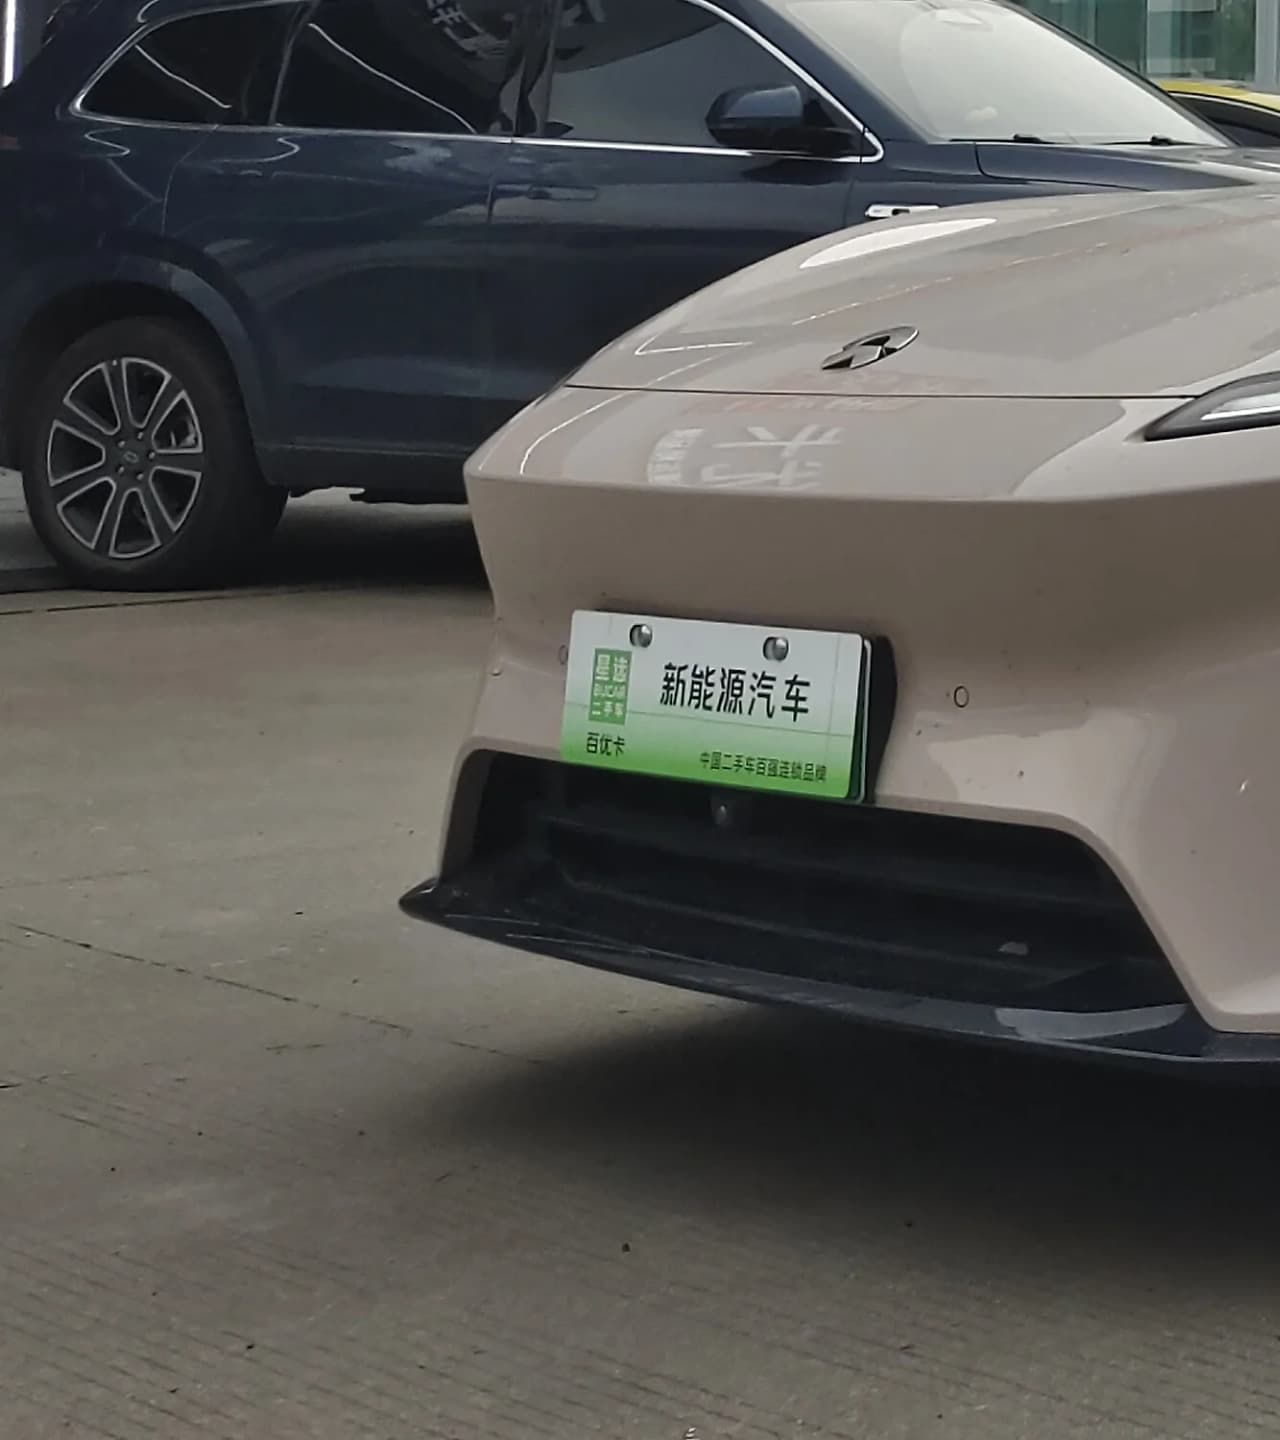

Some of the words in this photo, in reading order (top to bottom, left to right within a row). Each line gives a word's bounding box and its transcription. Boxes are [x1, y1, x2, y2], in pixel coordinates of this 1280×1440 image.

[660, 662, 811, 722] 新能源汽车
[586, 732, 625, 757] 百优卡
